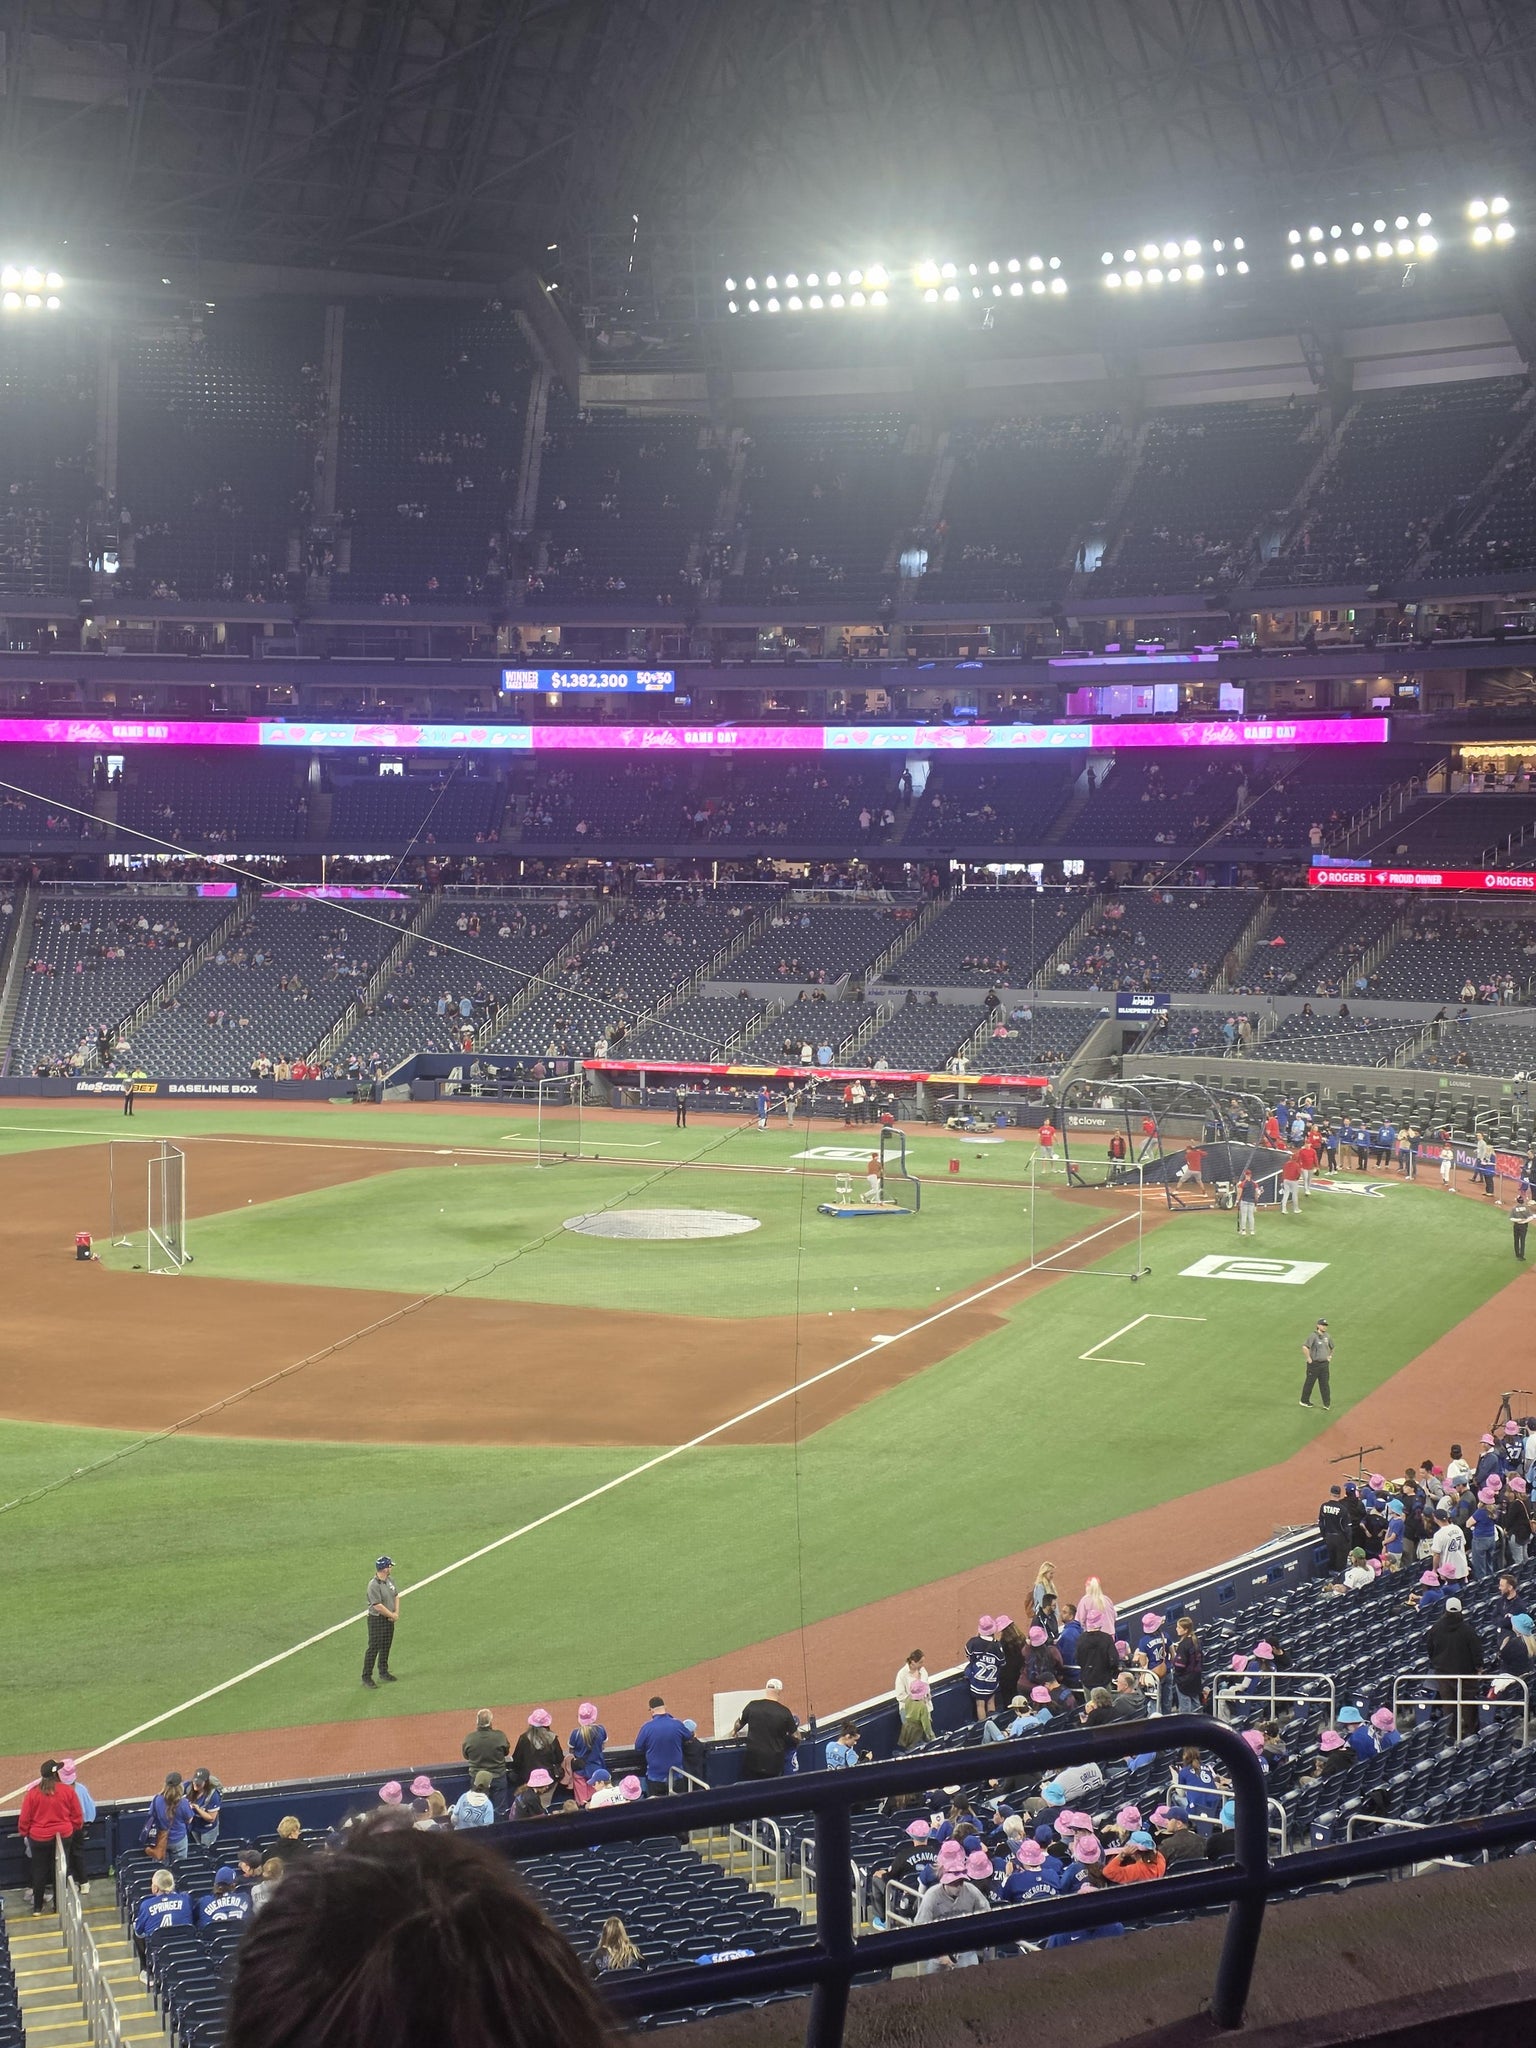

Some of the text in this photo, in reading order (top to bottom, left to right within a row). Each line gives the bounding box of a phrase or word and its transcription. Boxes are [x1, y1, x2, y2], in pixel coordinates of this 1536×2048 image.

[505, 671, 539, 682] WINNER
[112, 725, 143, 738] GAME
[147, 726, 168, 738] DAY
[1201, 725, 1296, 744] Barbie GAME DAY
[641, 729, 738, 748] Barbie GAME DAY
[1329, 872, 1442, 885] ROGERS PROUD OWNER
[1496, 876, 1534, 887] ROGERS
[76, 1081, 128, 1092] theScor
[168, 1084, 258, 1093] BASELINE BOX
[1449, 1080, 1472, 1088] LOUNGE
[1078, 1116, 1106, 1125] clover
[1456, 1149, 1477, 1167] May
[1322, 1506, 1341, 1515] STAFF
[974, 1661, 998, 1682] 22
[463, 1808, 483, 1823] 27
[1022, 1884, 1050, 1900] GUERRERO
[148, 1899, 184, 1916] SPRINGER
[203, 1895, 241, 1916] GUERRERO
[159, 1913, 173, 1927] 4
